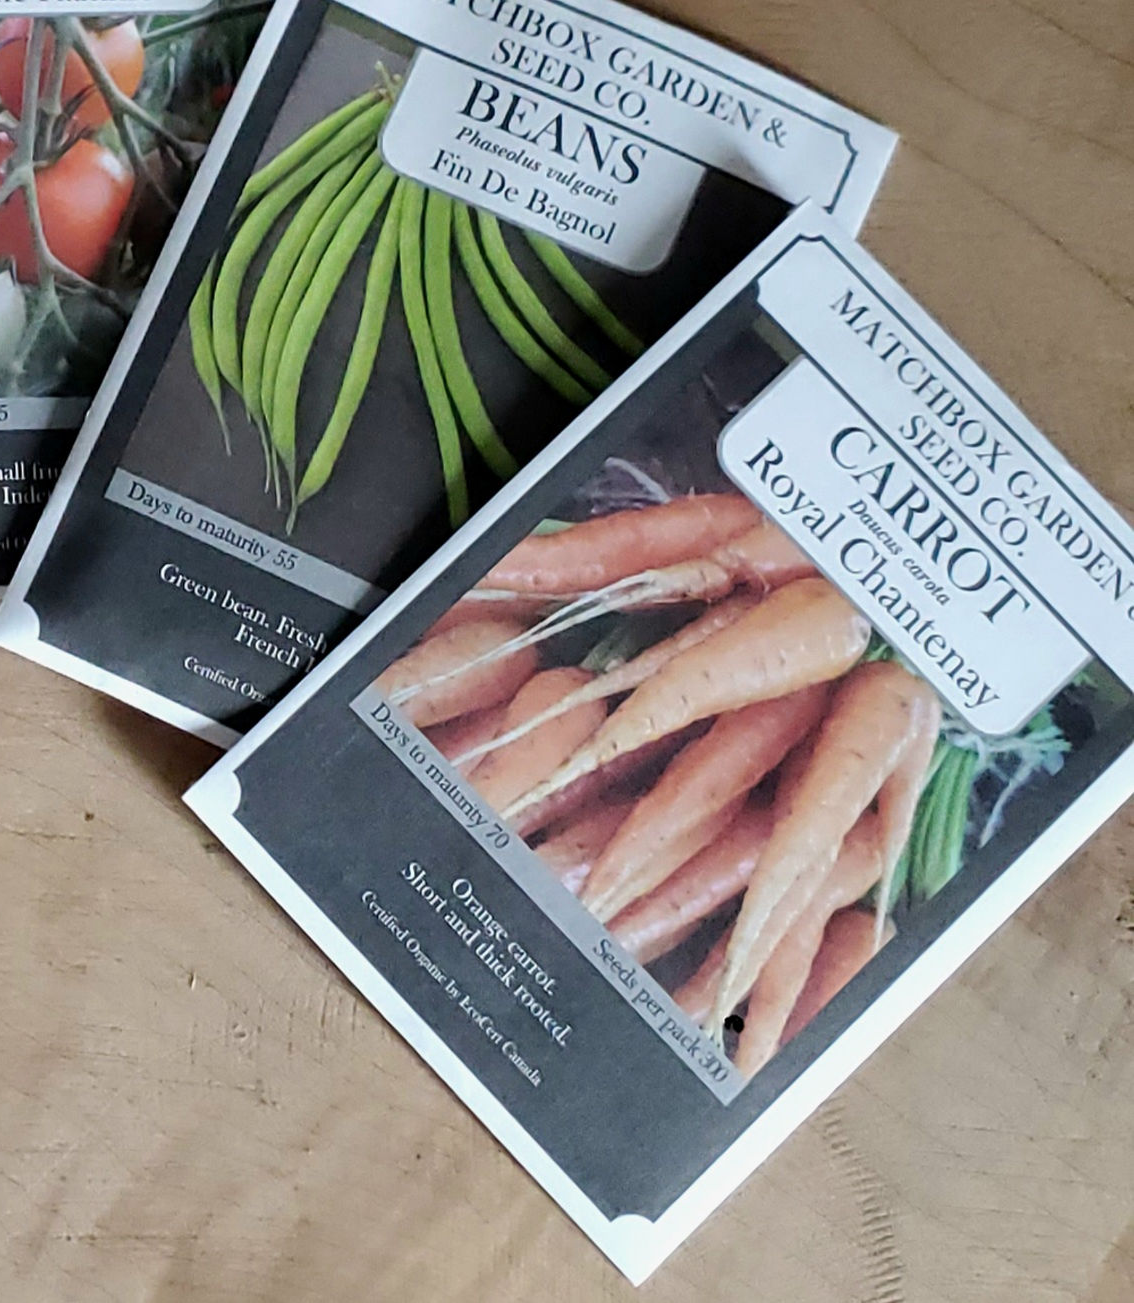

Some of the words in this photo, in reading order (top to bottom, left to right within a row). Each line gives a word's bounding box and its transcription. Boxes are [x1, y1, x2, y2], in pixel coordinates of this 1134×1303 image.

[457, 78, 648, 186] BEANS
[492, 38, 585, 94] SEED
[594, 80, 652, 126] CO.
[609, 46, 762, 133] GARDEN
[762, 118, 788, 149] &
[429, 149, 474, 186] Fin
[480, 168, 520, 204] De
[525, 189, 618, 245] Bagnol
[456, 127, 541, 173] Phaseolus
[545, 165, 620, 207] vulgaris
[828, 289, 1011, 474] MATCHBOX
[1007, 470, 1134, 601] GARDEN
[900, 414, 981, 498] SEED
[980, 496, 1031, 557] CO.
[127, 481, 172, 515] Days
[175, 507, 194, 524] to
[197, 516, 270, 562] maturity
[273, 549, 298, 570] 55
[744, 438, 846, 543] Royal
[839, 537, 1000, 709] Chantenay
[829, 426, 1031, 625] CARROT
[848, 498, 904, 557] Daucus
[903, 557, 951, 606] carota
[159, 562, 217, 603] Green
[221, 590, 270, 628] bean.
[234, 623, 300, 668] French
[184, 656, 240, 691] Certified
[369, 702, 411, 752] Days
[410, 743, 426, 765] to
[425, 761, 489, 829] maturity
[484, 823, 511, 850] 70
[361, 891, 409, 942] Certified
[406, 938, 448, 985] Organic
[444, 980, 461, 1000] by
[459, 996, 503, 1044] EcoCert
[502, 1041, 542, 1087] Canada
[401, 862, 448, 913] Short
[444, 910, 481, 947] and
[475, 942, 516, 988] thick
[513, 985, 574, 1047] rooted.
[452, 878, 508, 941] Orange
[507, 942, 559, 996] carrot.
[594, 939, 638, 989] Seeds
[631, 988, 665, 1018] per
[658, 1018, 701, 1058] pack
[698, 1051, 730, 1082] 300
